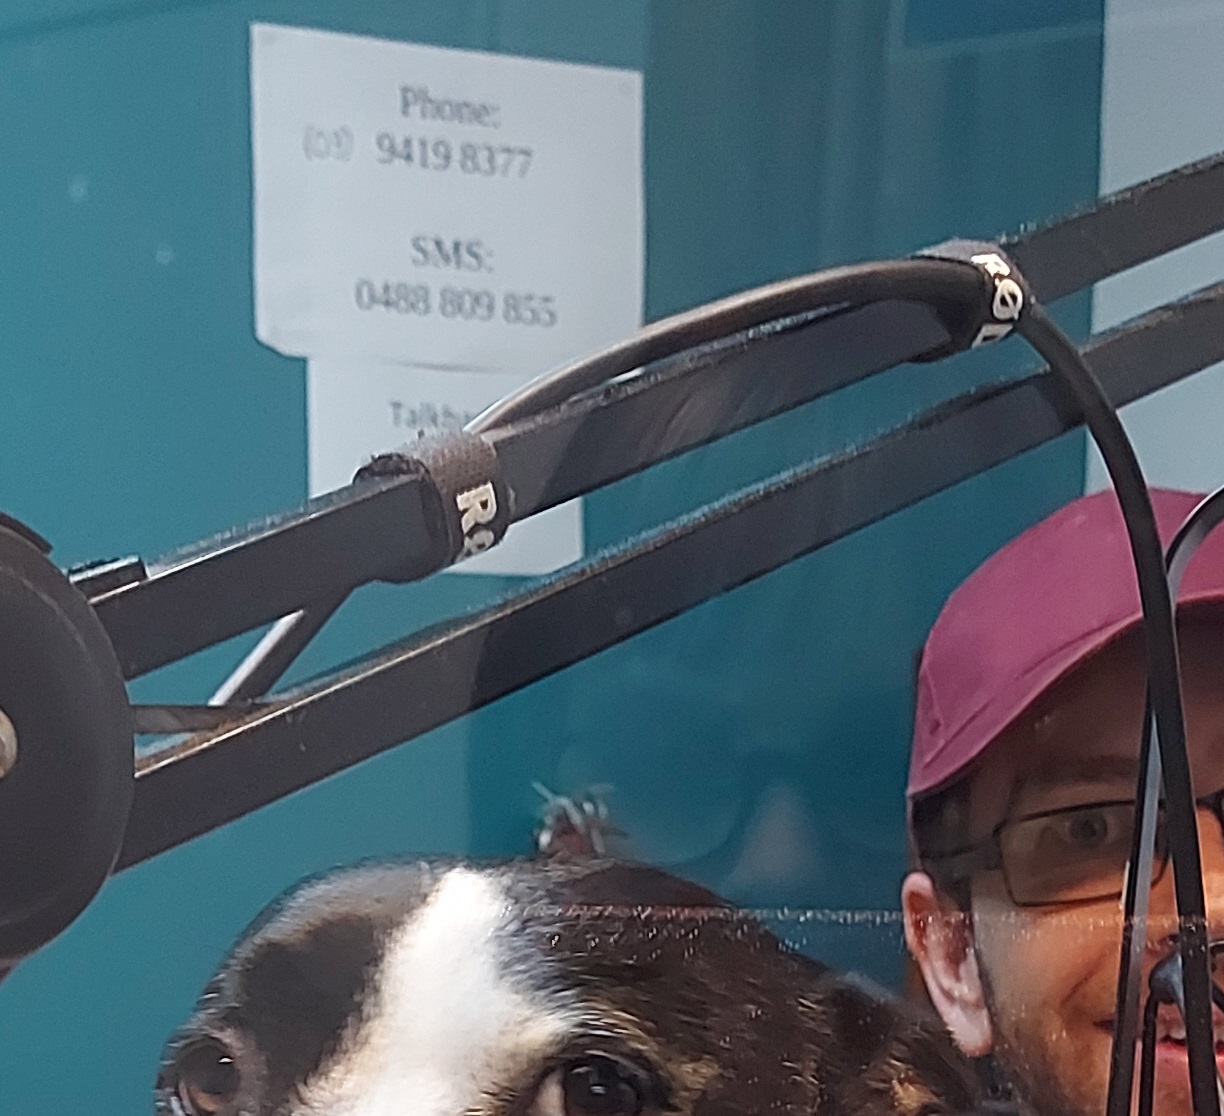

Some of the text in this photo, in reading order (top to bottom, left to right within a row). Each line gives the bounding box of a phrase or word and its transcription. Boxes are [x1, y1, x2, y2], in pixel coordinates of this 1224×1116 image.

[400, 84, 502, 129] Phone:
[375, 131, 453, 172] 9419
[459, 143, 534, 179] 8377
[410, 234, 494, 274] SMS:
[354, 277, 559, 328] 0488 809 855
